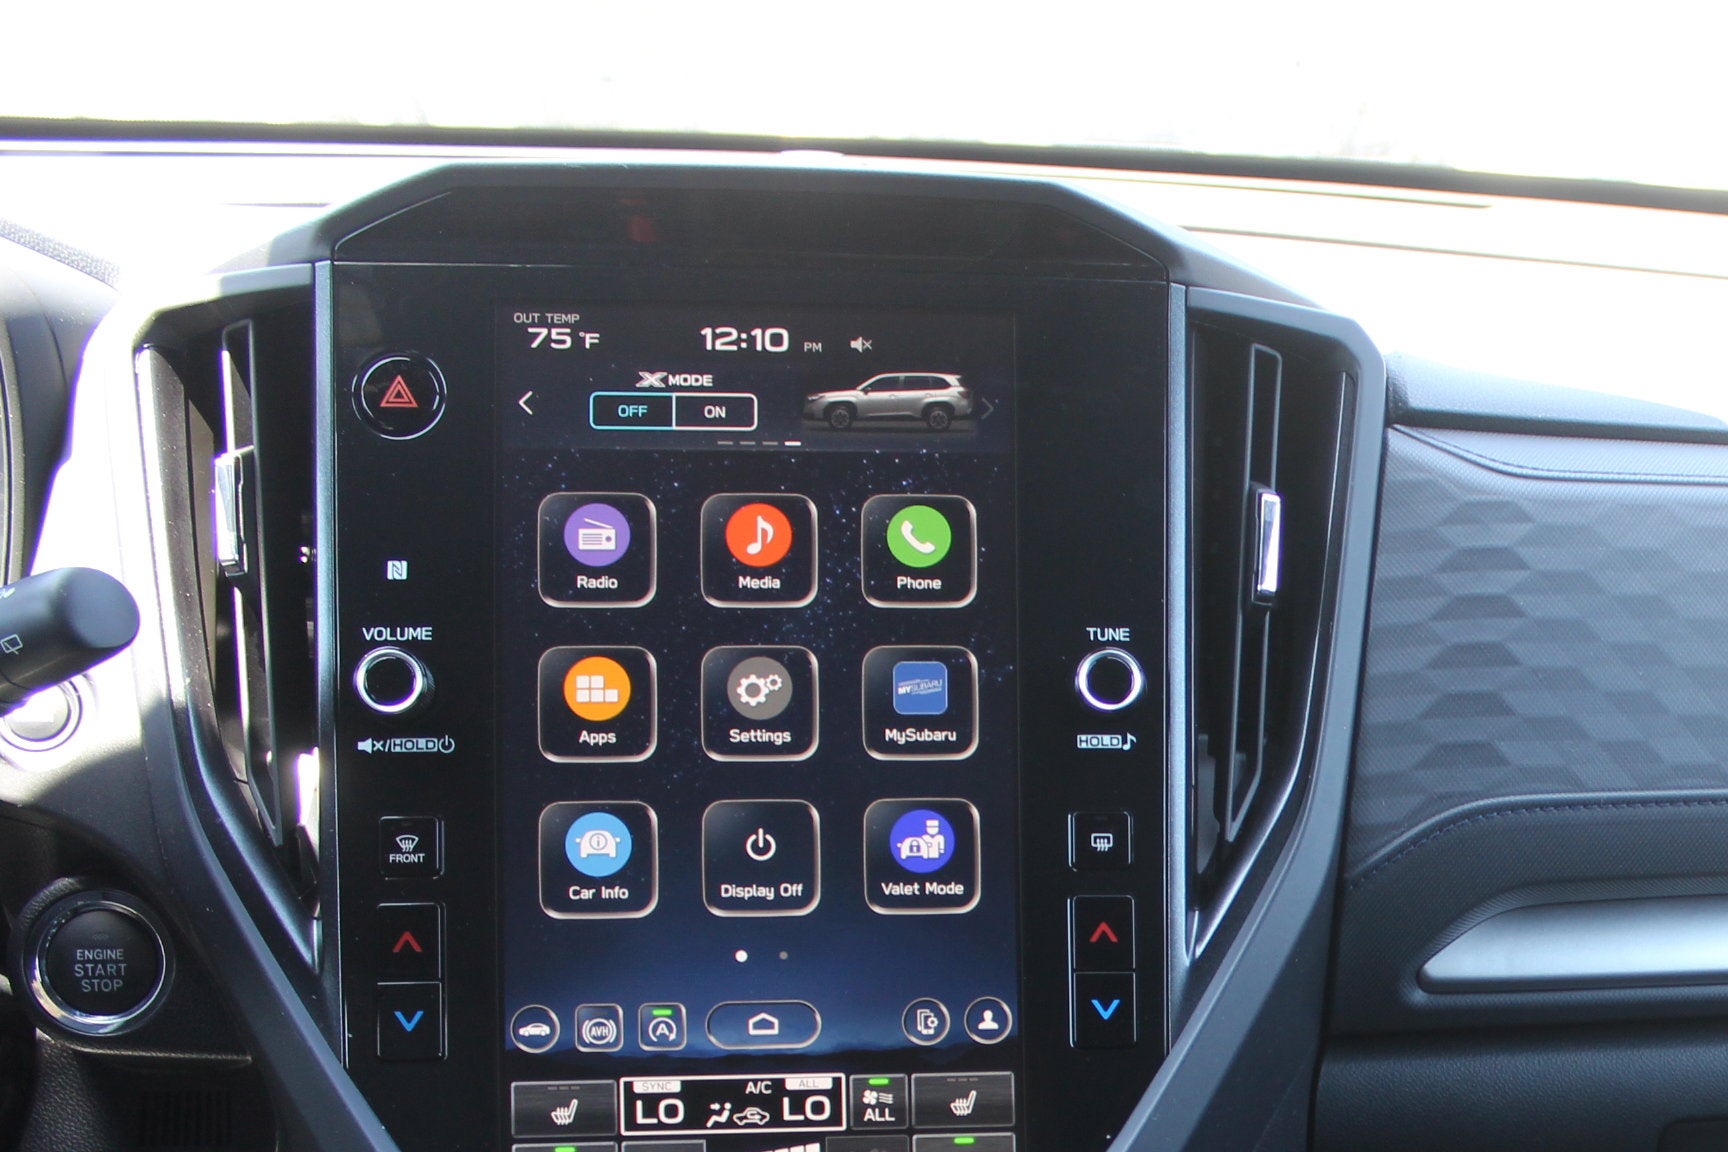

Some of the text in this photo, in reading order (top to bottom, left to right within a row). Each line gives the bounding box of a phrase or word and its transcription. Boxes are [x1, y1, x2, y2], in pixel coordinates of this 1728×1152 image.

[513, 313, 580, 324] OUT TEMP
[527, 327, 572, 350] 75
[699, 327, 822, 353] 12:10 PM
[618, 404, 726, 419] OFF ON
[576, 575, 618, 589] Radio
[738, 575, 781, 590] Media
[896, 576, 942, 590] Phone
[362, 627, 433, 641] VOLUME
[1086, 627, 1131, 641] TUNE
[578, 730, 617, 745] Apps
[729, 729, 791, 745] Settings
[885, 728, 957, 744] MySubaru
[1077, 734, 1122, 749] HOLD
[389, 853, 425, 863] FRONT
[568, 886, 629, 900] Car Info
[720, 883, 803, 901] Display Off
[881, 882, 964, 896] Valet Mode
[76, 949, 124, 960] ENGINE
[74, 963, 127, 977] START
[81, 979, 123, 992] STOP
[590, 1025, 609, 1038] AVH
[641, 1081, 672, 1092] SYNC
[745, 1081, 772, 1095] A/C
[798, 1080, 820, 1089] ALL
[635, 1099, 685, 1125] LO
[782, 1095, 831, 1121] LO
[863, 1108, 896, 1122] ALL
